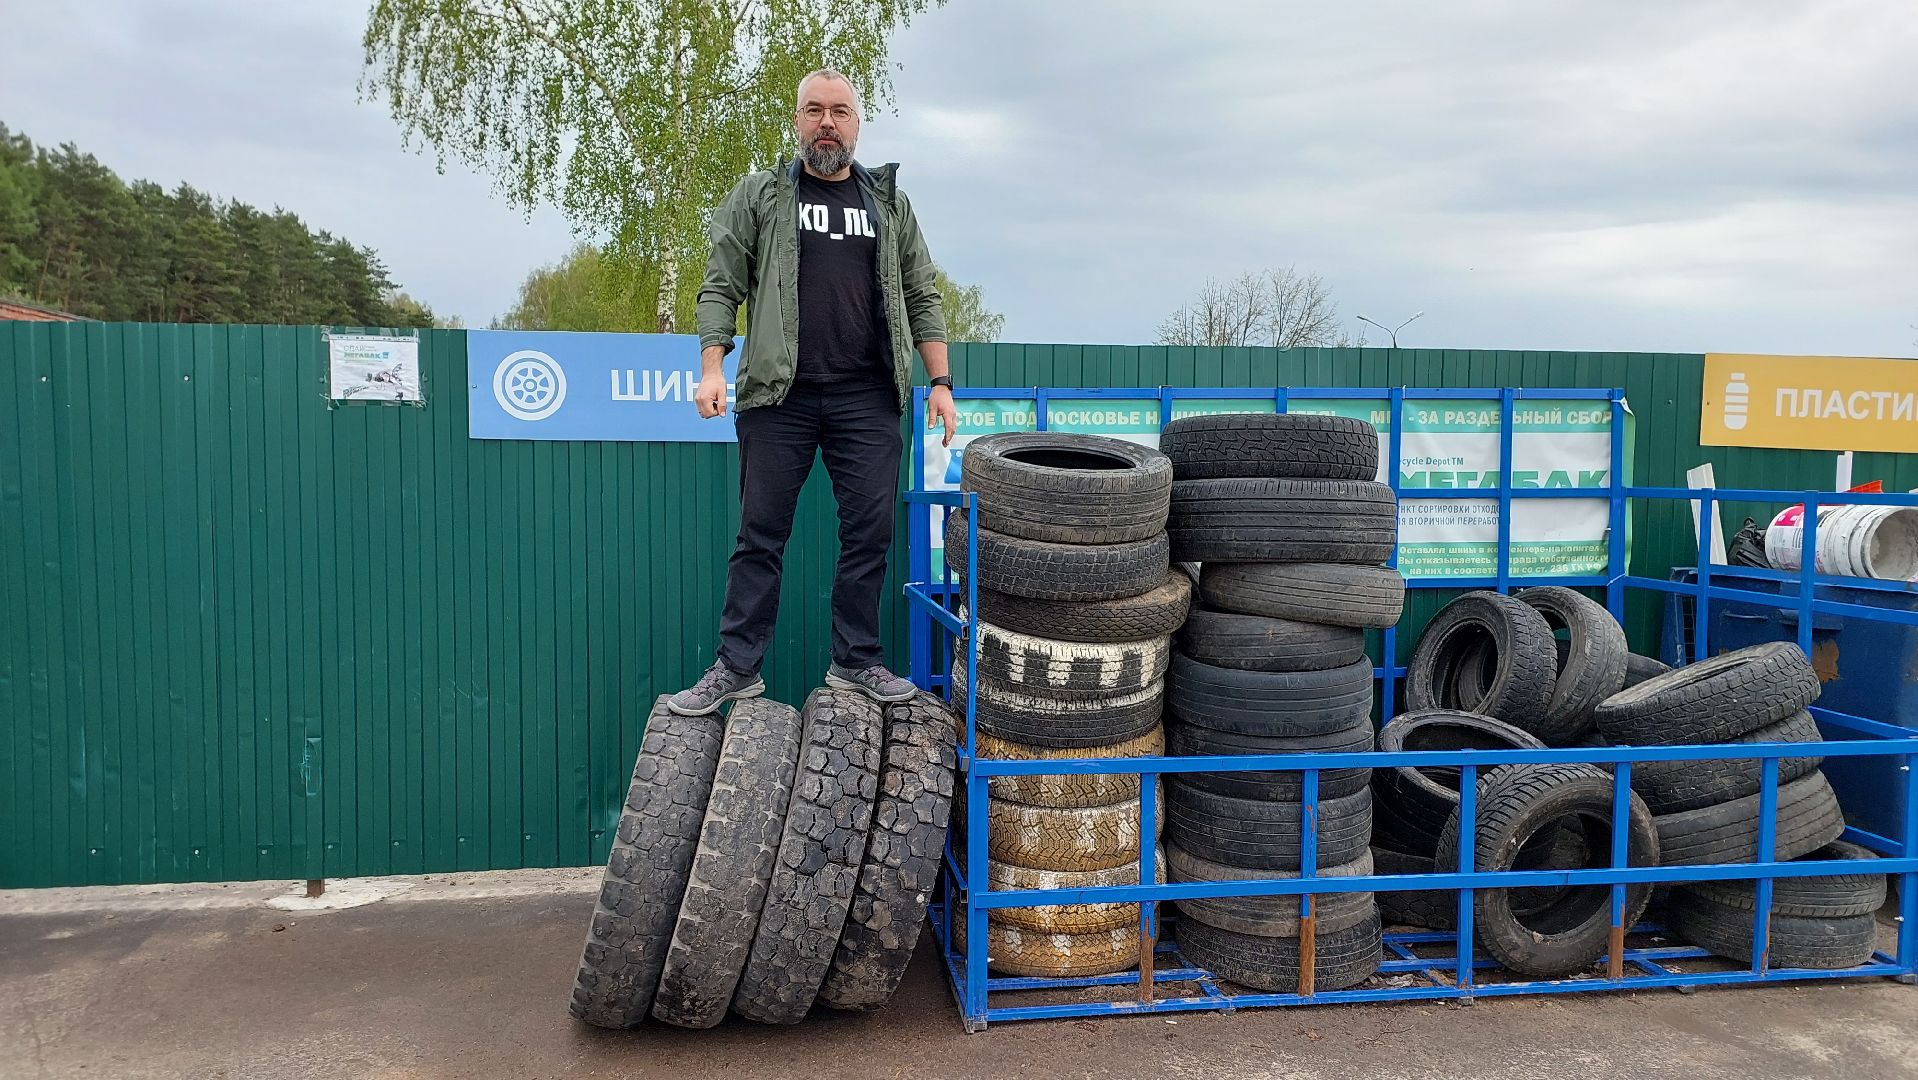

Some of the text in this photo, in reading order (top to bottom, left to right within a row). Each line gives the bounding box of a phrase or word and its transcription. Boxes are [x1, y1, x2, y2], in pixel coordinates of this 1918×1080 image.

[611, 369, 736, 402] ШИН
[1418, 410, 1439, 425] ЗА
[1444, 407, 1561, 427] РАЗДЕЬНЫЙ
[1775, 388, 1918, 421] ПЛАСТИ
[1400, 457, 1424, 467] cycle
[1425, 457, 1451, 467] Depot
